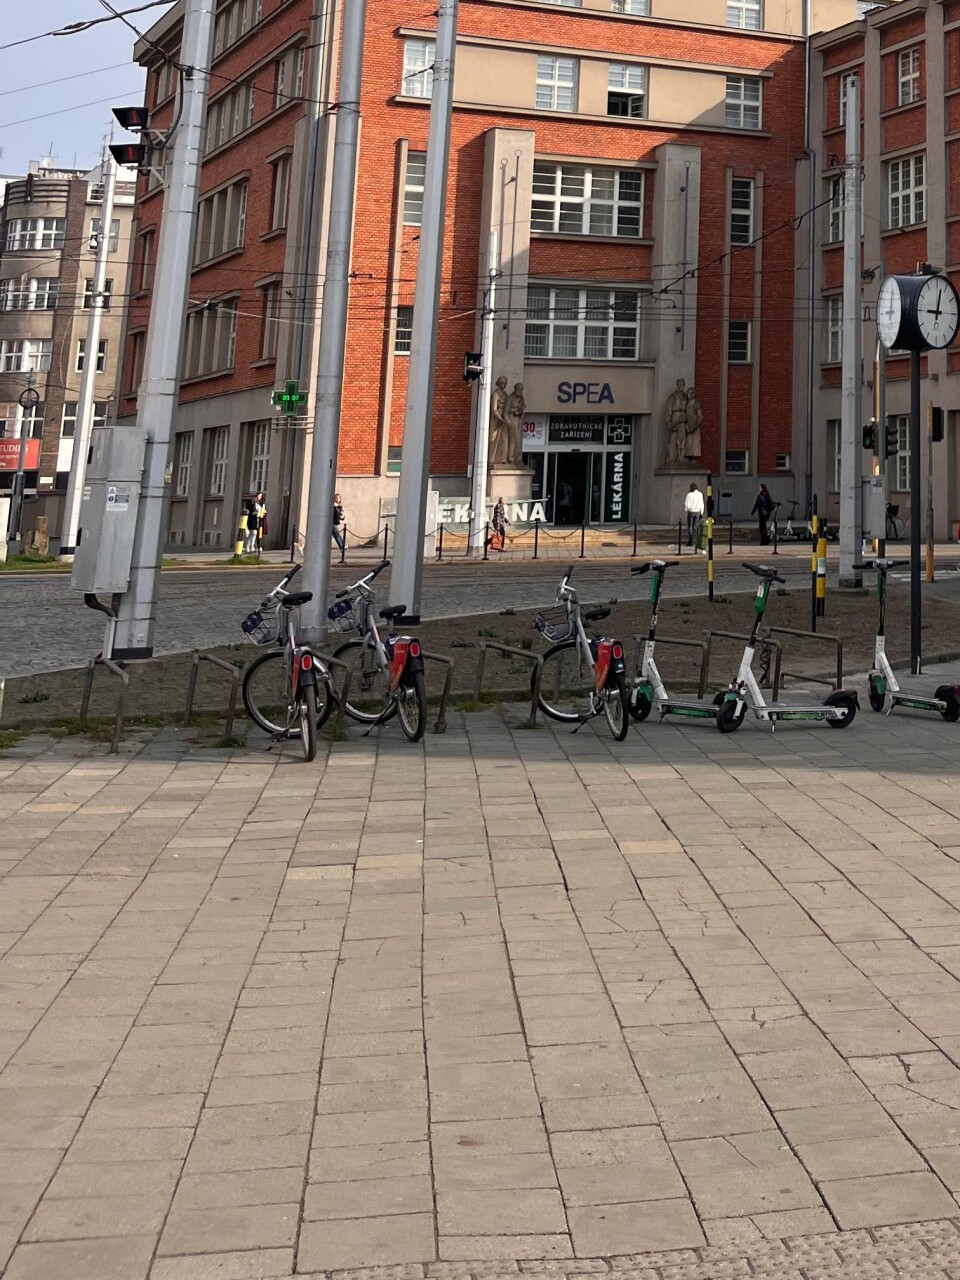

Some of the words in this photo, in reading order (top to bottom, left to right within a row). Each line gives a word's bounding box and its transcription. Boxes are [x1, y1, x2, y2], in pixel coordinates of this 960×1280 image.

[557, 381, 615, 404] SPEA
[523, 421, 536, 433] 30
[550, 421, 604, 430] ZDRAVOTNICKÉ
[560, 429, 593, 439] ZAŘÍZENÍ
[611, 452, 624, 519] LÉKÁRNA
